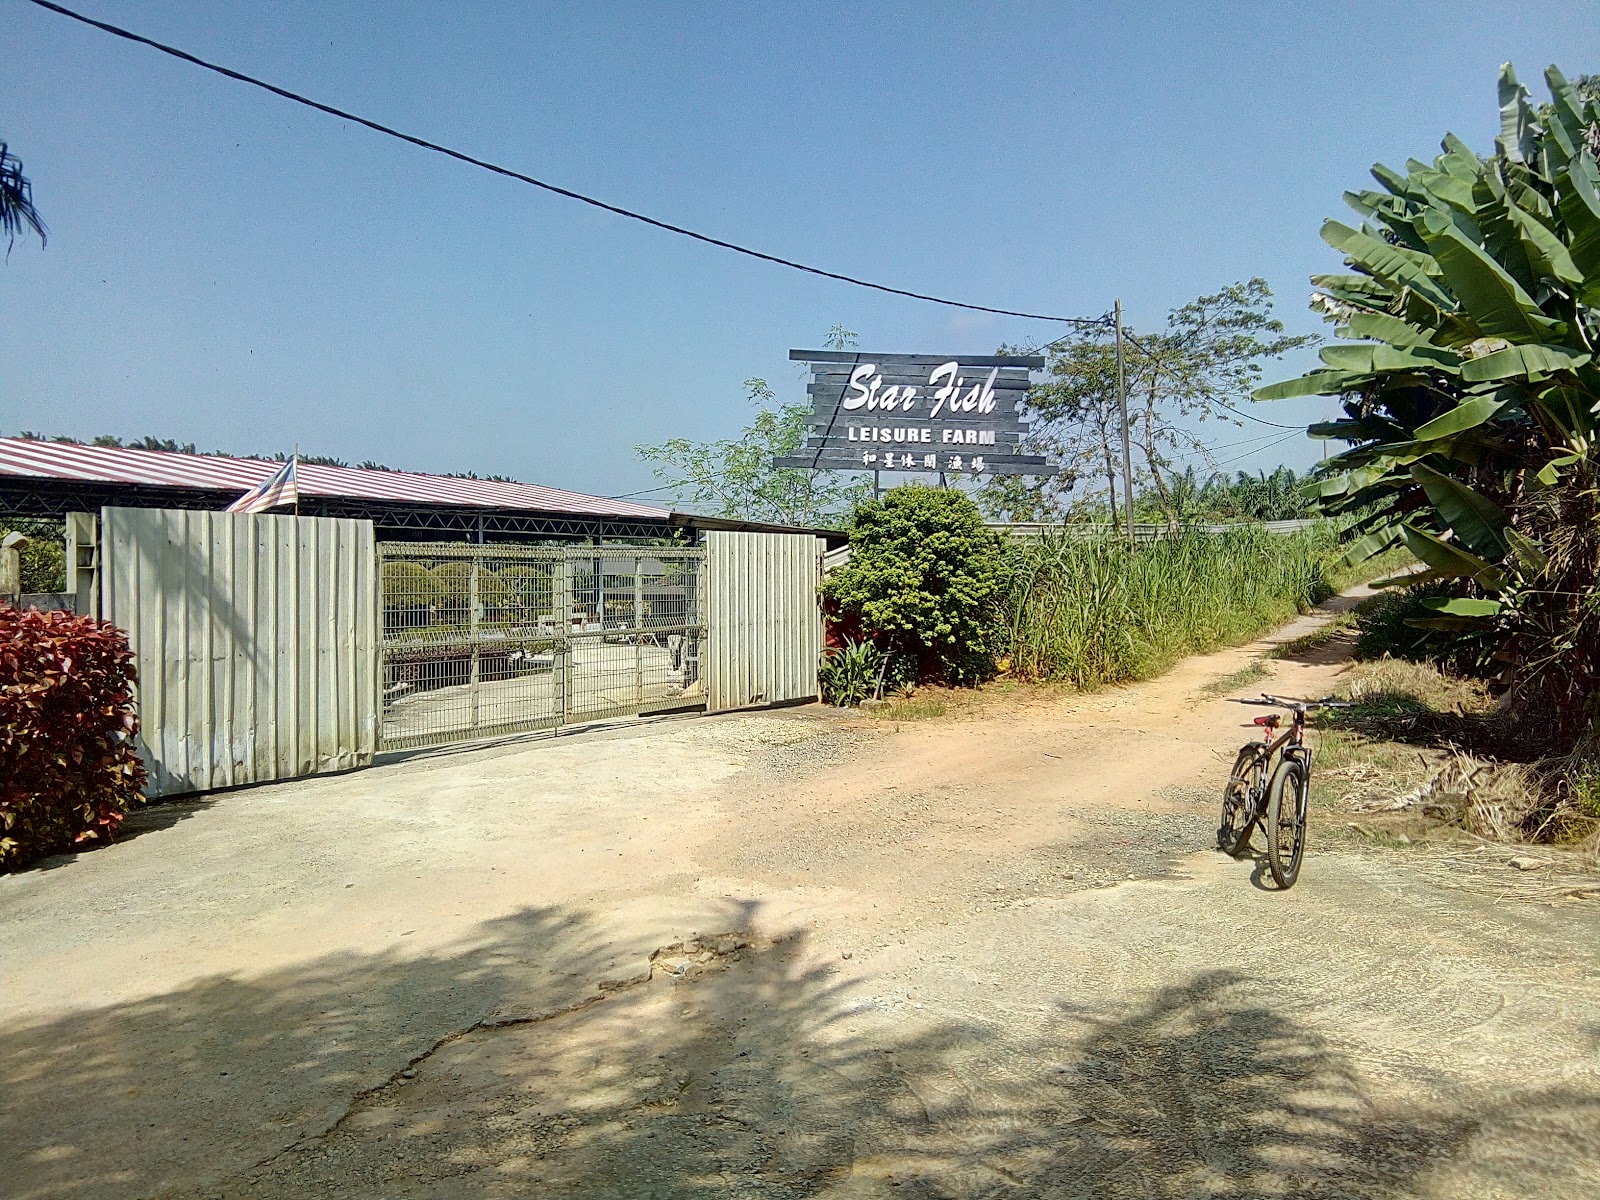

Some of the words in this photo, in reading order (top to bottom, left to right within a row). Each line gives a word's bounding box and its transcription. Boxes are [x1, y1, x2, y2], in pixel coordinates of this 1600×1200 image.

[843, 363, 917, 412] Star
[929, 361, 999, 418] Fish
[848, 426, 932, 443] LEISURE
[942, 429, 996, 446] FARM
